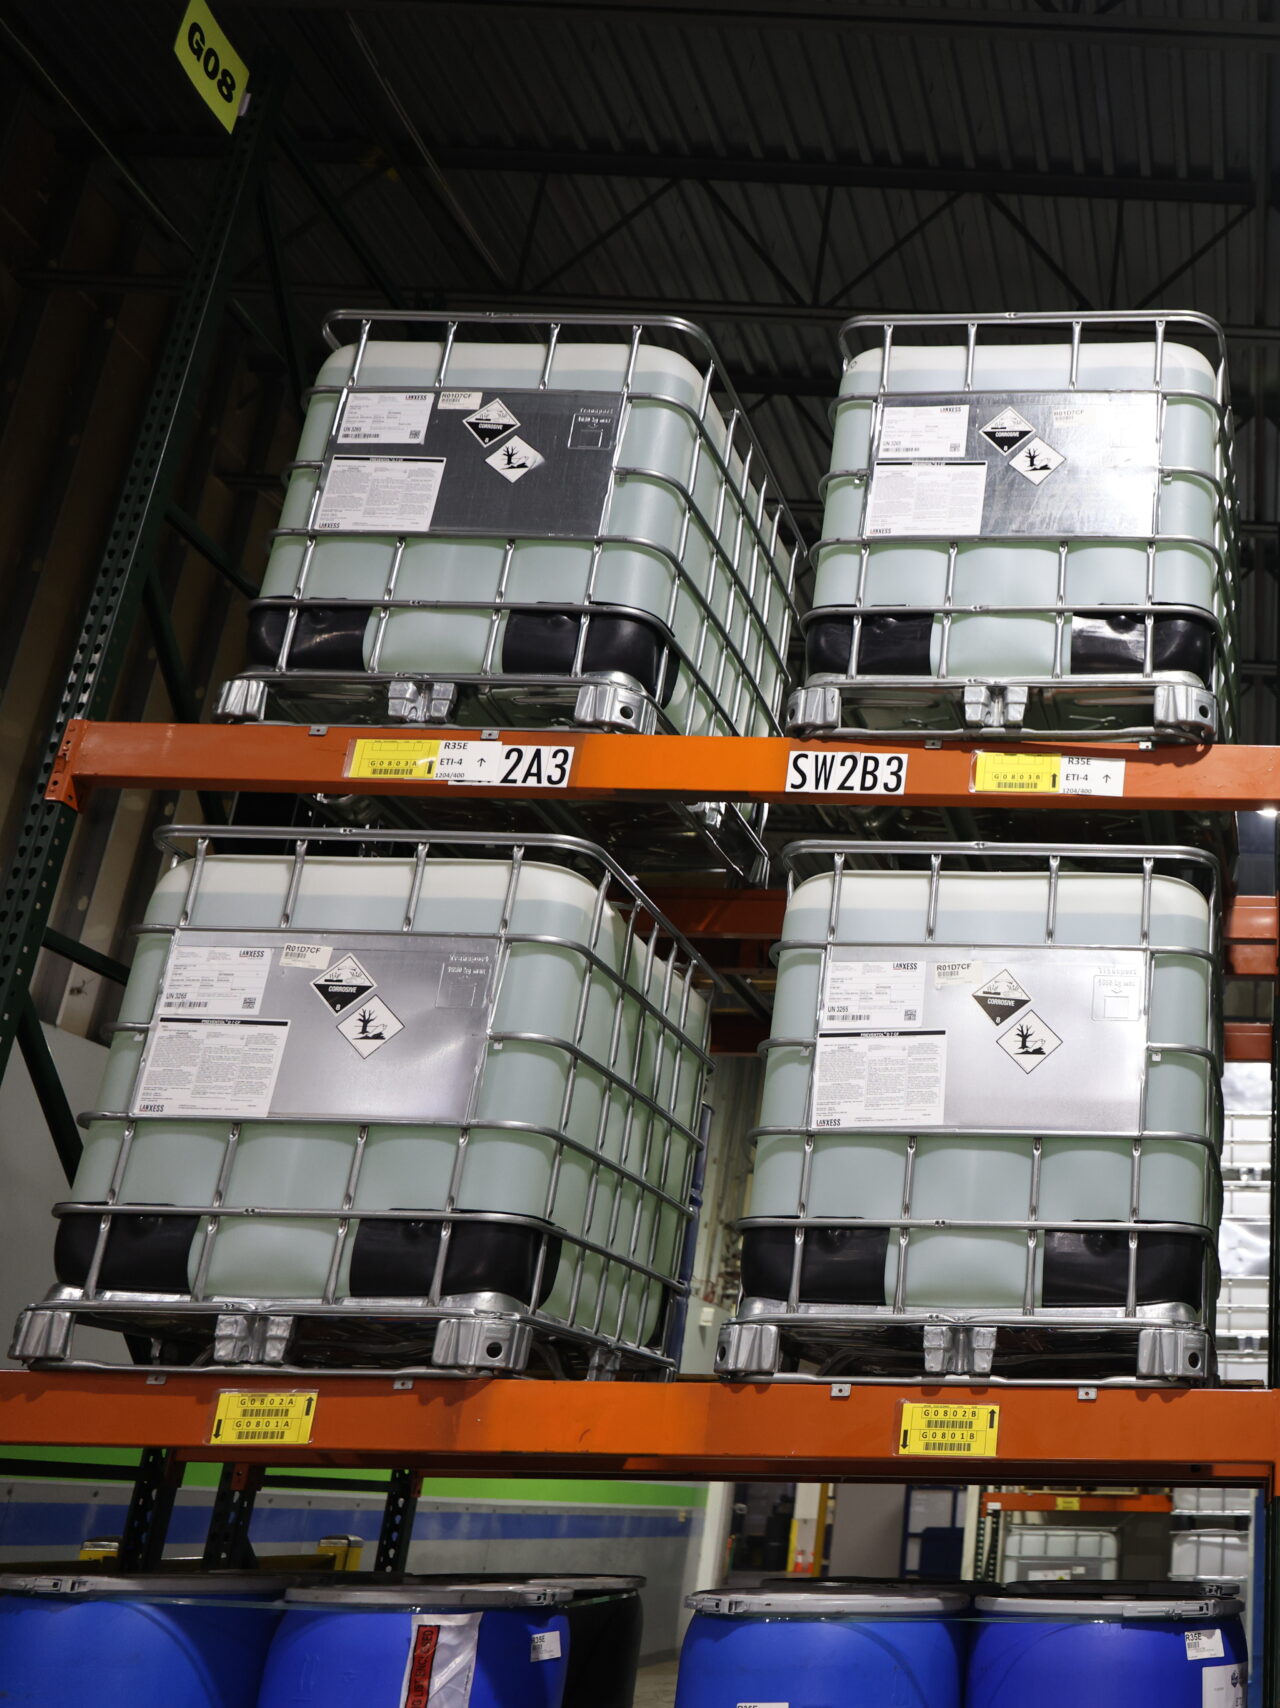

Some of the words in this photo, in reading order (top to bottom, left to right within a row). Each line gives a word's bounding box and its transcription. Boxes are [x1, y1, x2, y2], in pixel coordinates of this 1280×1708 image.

[187, 21, 236, 104] G08
[478, 423, 503, 431] CORROSIVE
[444, 742, 468, 750] R35E
[439, 758, 463, 766] ETI-4
[1068, 757, 1092, 766] R35E
[790, 753, 904, 793] SW2B3
[1066, 773, 1088, 782] ETI-4
[285, 944, 321, 954] R01D7CF
[239, 950, 264, 958] LANXESS
[892, 962, 918, 970] LANXESS
[936, 962, 972, 972] R01D7CF
[328, 986, 358, 994] CORROSIVE
[987, 998, 1015, 1007] CORROSIVE
[139, 1104, 164, 1112] LANXESS
[816, 1118, 841, 1126] LANXESS
[1186, 1632, 1202, 1641] R35E
